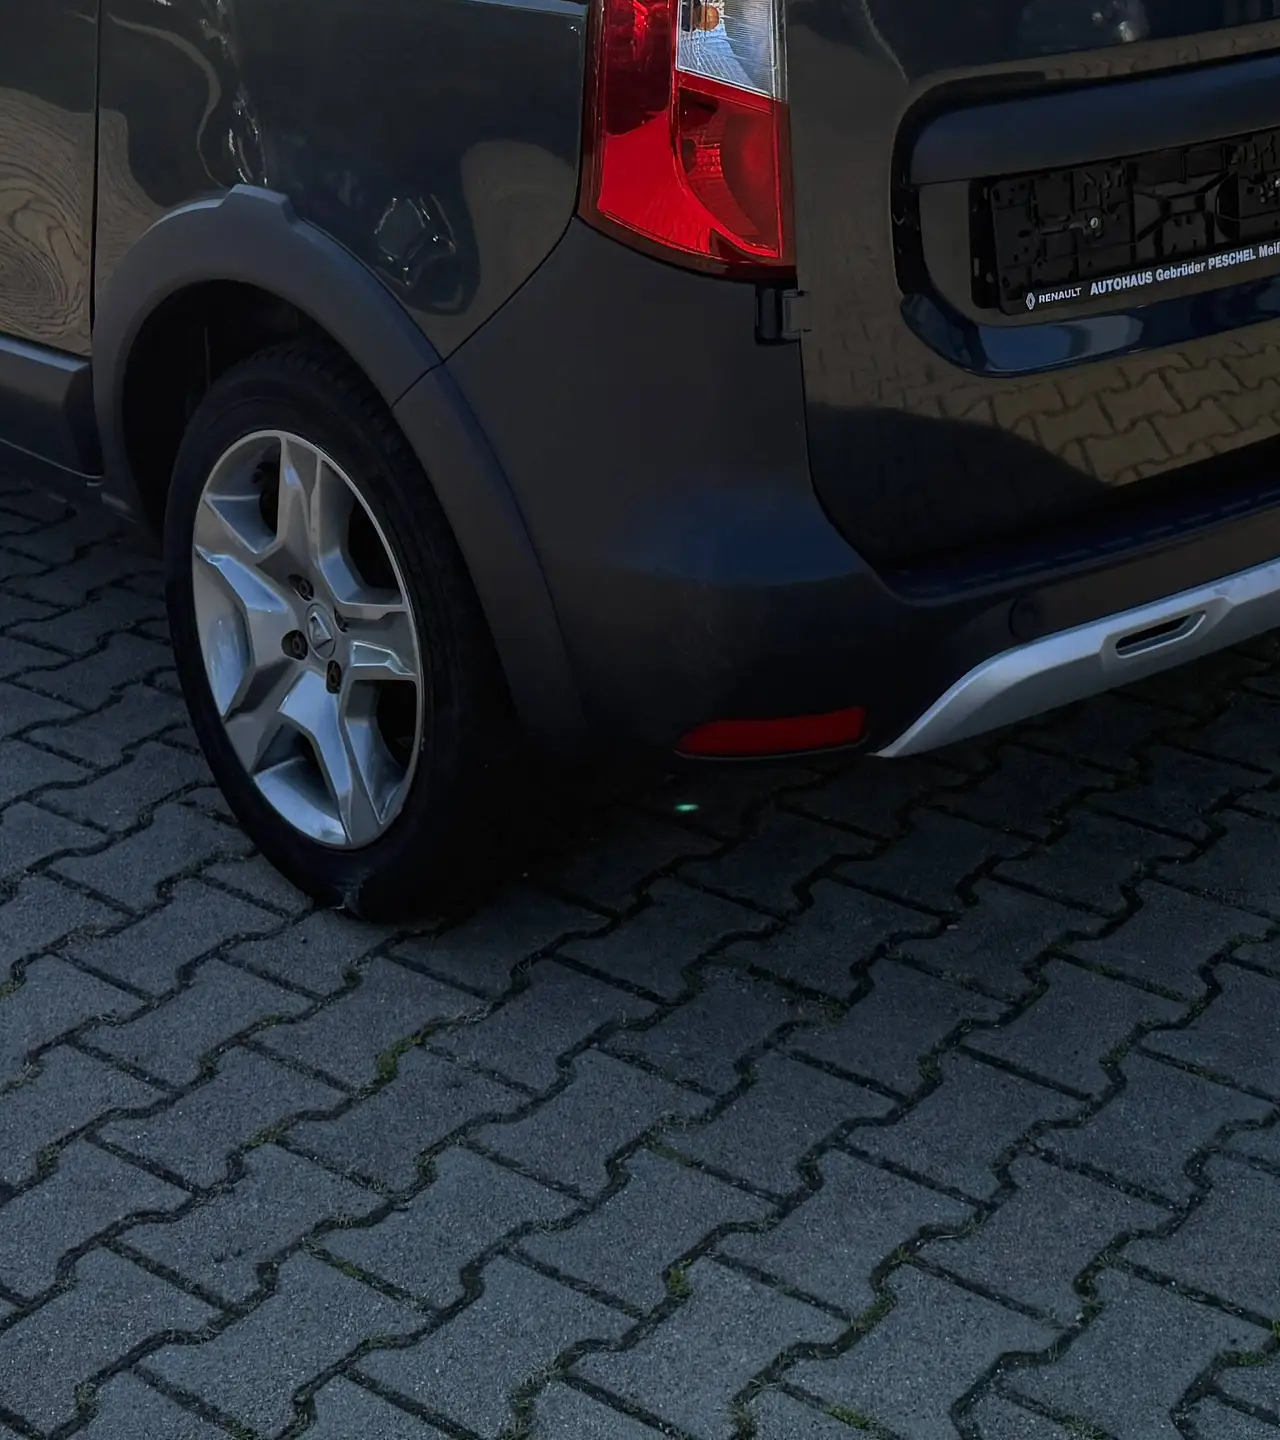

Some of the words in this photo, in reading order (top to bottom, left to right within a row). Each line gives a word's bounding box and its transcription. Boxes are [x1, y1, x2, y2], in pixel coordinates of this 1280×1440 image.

[1038, 287, 1082, 304] RENAULT
[1089, 271, 1153, 296] AUTOHAUS
[1155, 260, 1207, 282] Gebrüder
[1208, 247, 1257, 271] PESCHEL
